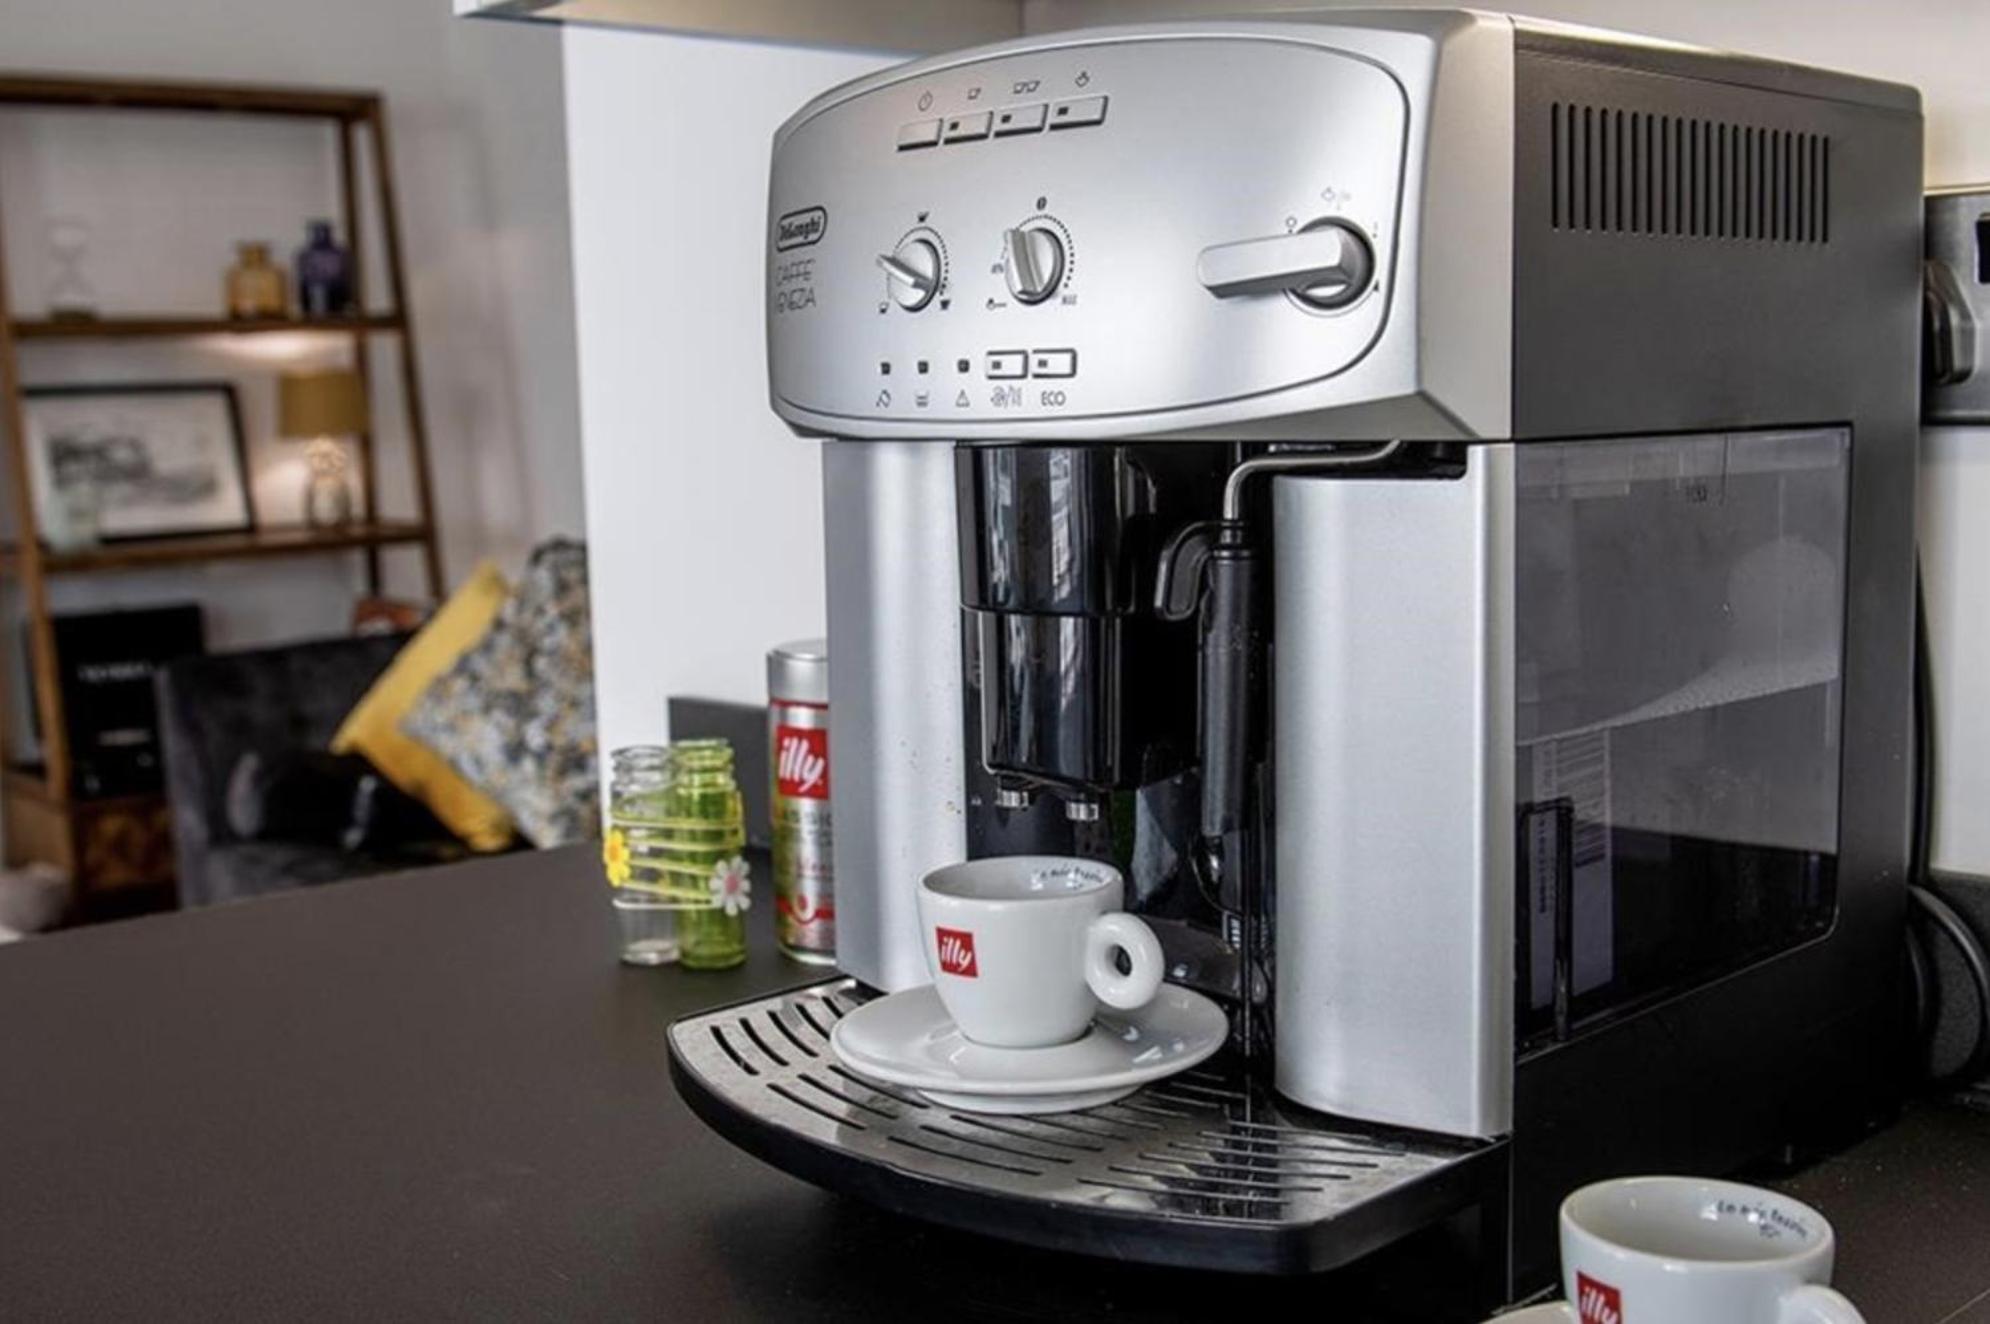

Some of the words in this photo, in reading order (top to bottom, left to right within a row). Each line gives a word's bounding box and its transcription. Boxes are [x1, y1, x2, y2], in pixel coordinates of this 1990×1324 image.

[1041, 391, 1067, 407] ECO
[778, 737, 825, 792] illy
[941, 936, 974, 972] illy
